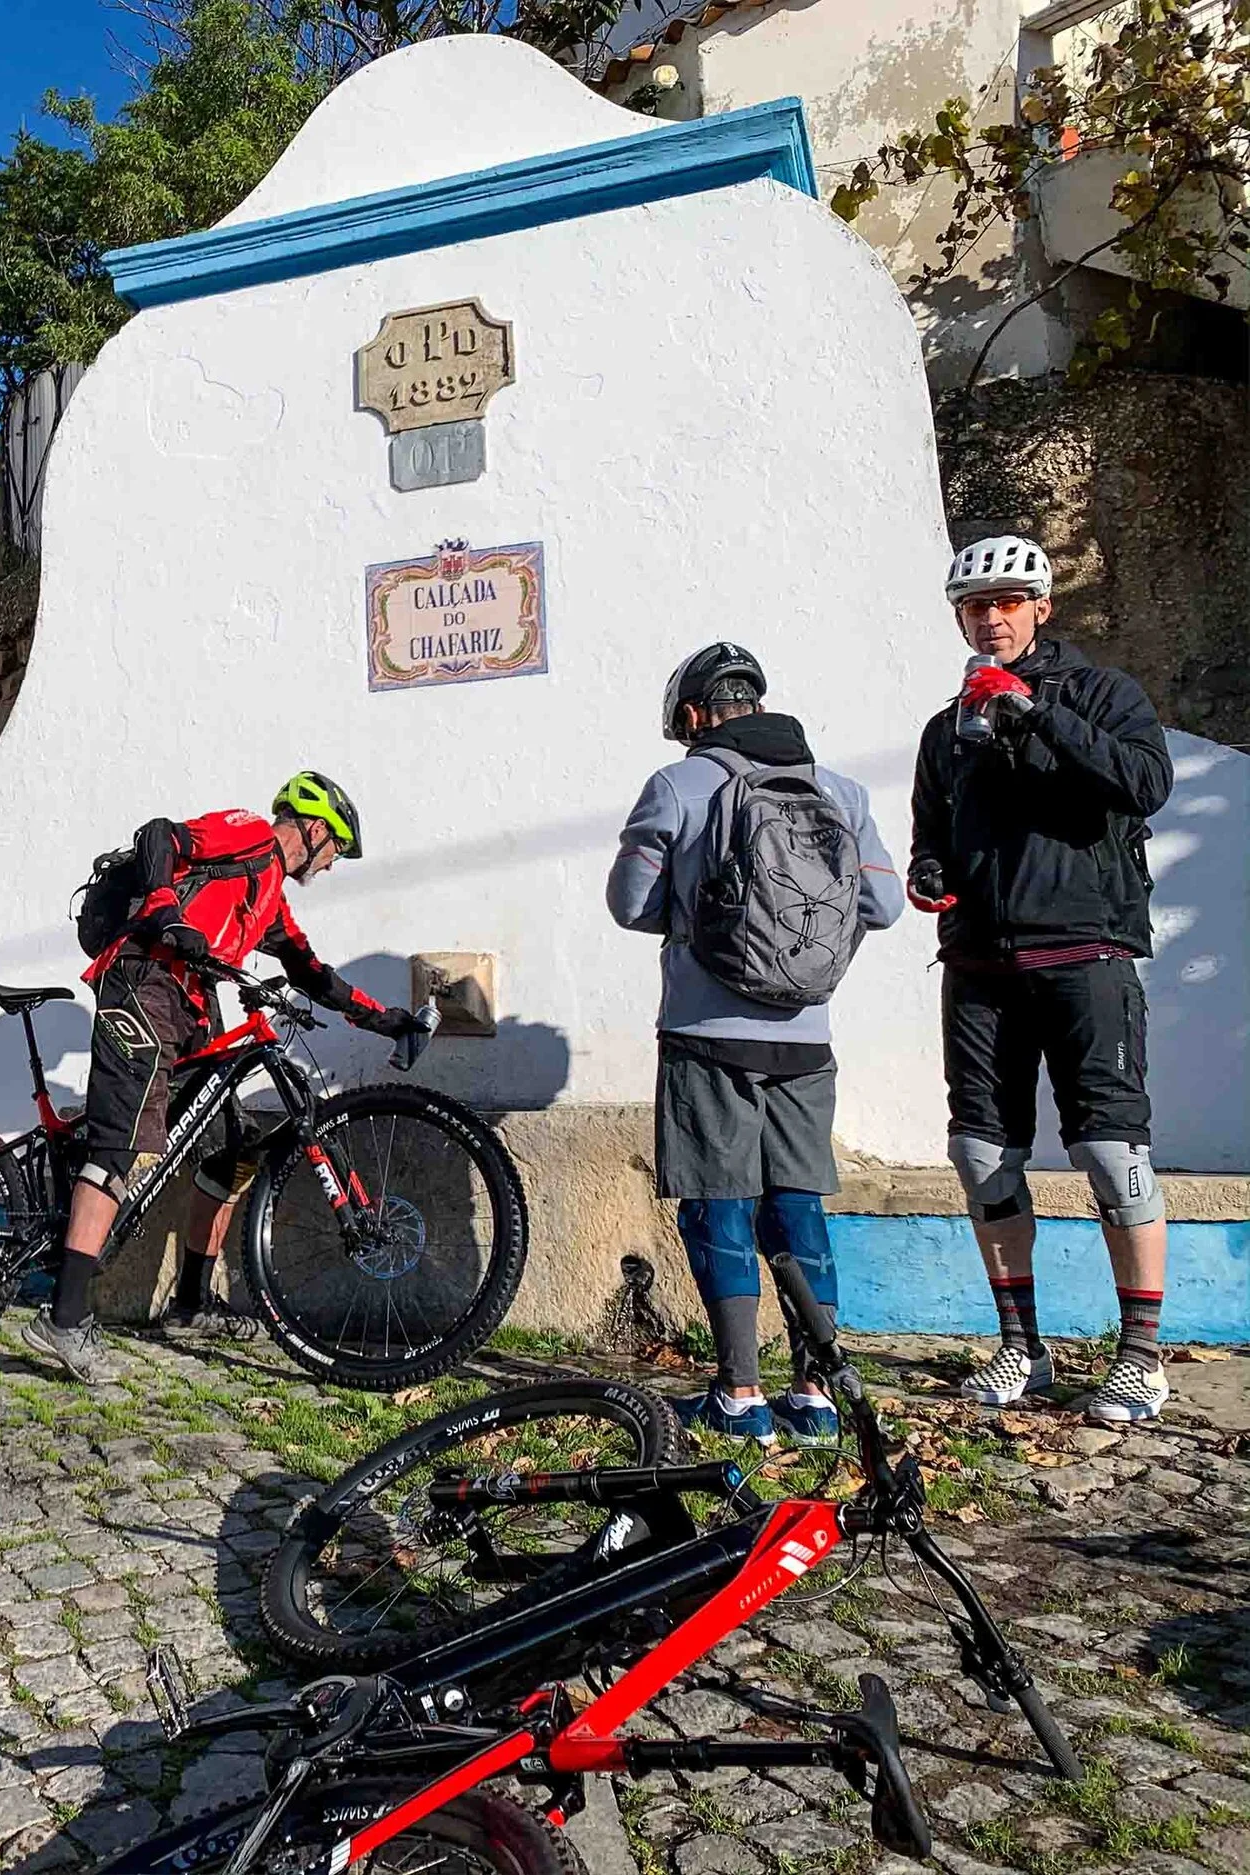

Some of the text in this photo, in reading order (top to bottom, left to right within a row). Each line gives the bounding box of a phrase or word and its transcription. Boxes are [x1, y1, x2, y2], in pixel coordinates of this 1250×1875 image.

[414, 579, 497, 610] CALÇADA
[443, 611, 466, 627] DO
[410, 627, 503, 661] CHAFARIZ
[426, 1103, 482, 1149] MAXXIS
[313, 1161, 342, 1201] FOX
[604, 1387, 650, 1426] MAXXIS
[445, 1416, 480, 1437] SWISS
[322, 1805, 369, 1823] SWISS
